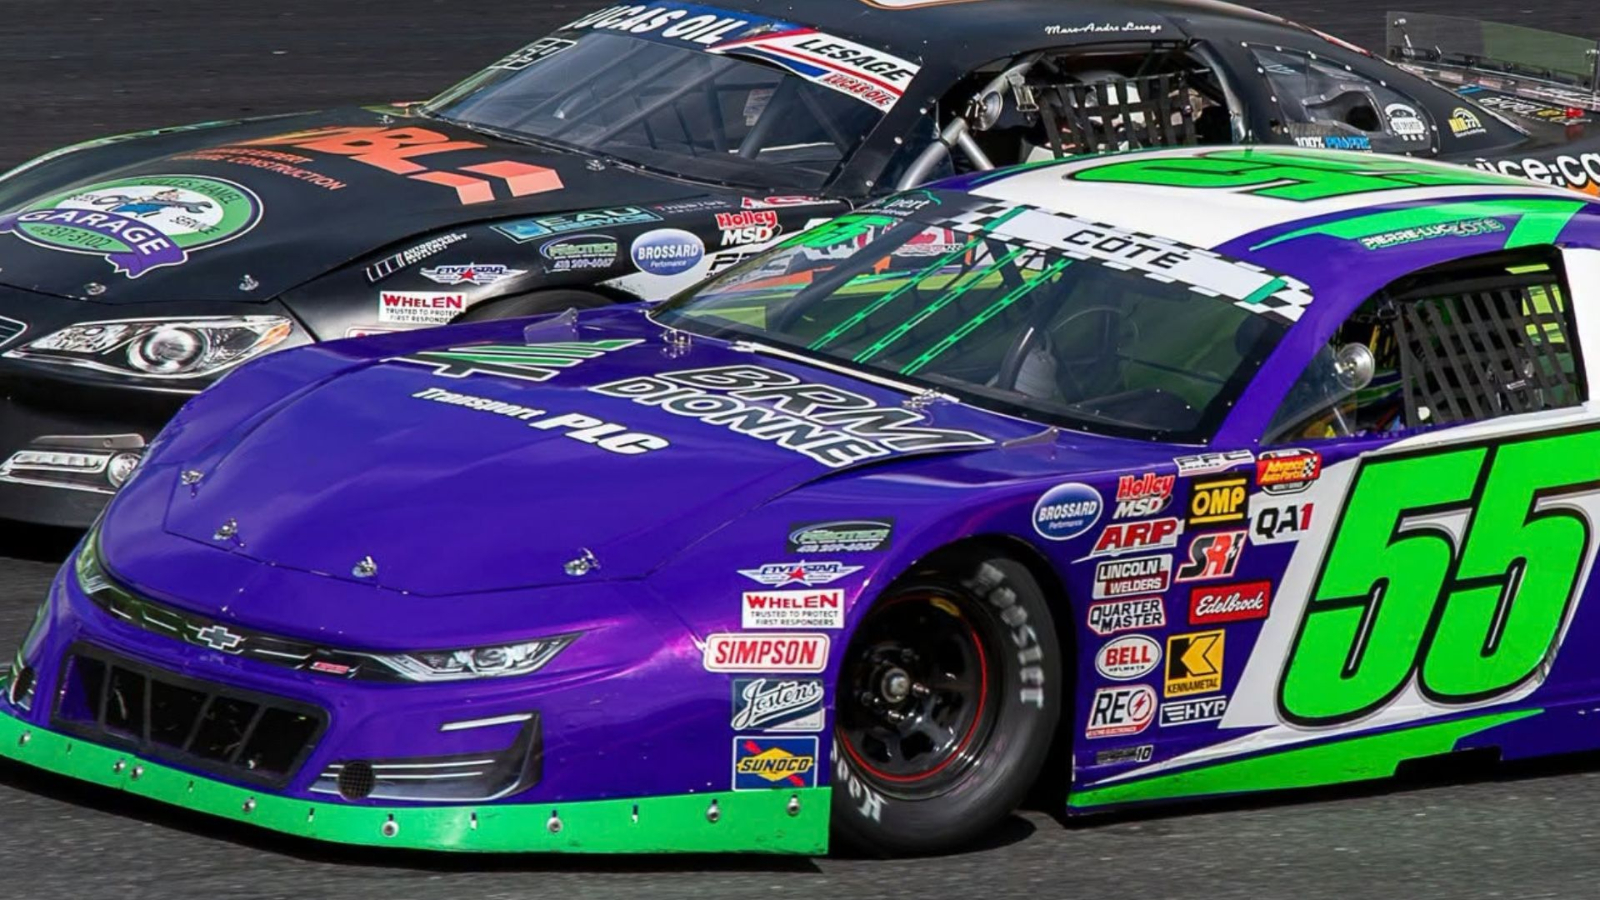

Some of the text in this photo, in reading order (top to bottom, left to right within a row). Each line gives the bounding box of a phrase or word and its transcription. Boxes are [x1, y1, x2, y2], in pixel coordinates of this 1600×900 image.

[557, 5, 748, 45] LUCAS OIL
[793, 38, 916, 81] LESAGE
[822, 73, 894, 108] LUCAS OIL
[715, 210, 778, 230] Holley
[17, 208, 171, 255] GARAGE
[721, 228, 774, 246] MSD
[638, 244, 698, 259] BROSSARD
[472, 265, 504, 274] STAR
[650, 260, 687, 268] Performance
[383, 293, 463, 309] WHELEN
[385, 308, 418, 316] TRUSTED
[412, 387, 546, 420] Transport
[655, 366, 995, 450] BRM
[588, 377, 891, 467] DIONNE
[529, 413, 670, 455] PLC
[1116, 473, 1175, 500] Holley
[1039, 501, 1097, 521] BROSSARD
[1113, 498, 1164, 519] MSD
[1192, 487, 1245, 517] OMP
[1049, 519, 1084, 530] Performance
[1255, 502, 1313, 539] QA1
[1094, 519, 1178, 551] ARP
[803, 564, 840, 574] STAR
[1100, 558, 1158, 580] LINCOLN
[1276, 424, 1600, 728] 55
[1110, 578, 1162, 595] WELDERS
[746, 592, 839, 609] WHELEN
[1195, 591, 1264, 616] Edelbrock
[751, 610, 788, 618] TRUSTED
[789, 610, 800, 618] TO
[756, 618, 835, 626] FIRST RESPONDERS
[1089, 599, 1160, 626] QUARTER
[1100, 612, 1163, 633] MASTER
[715, 640, 818, 665] SIMPSON
[1105, 645, 1152, 667] BELL
[1167, 679, 1219, 694] KENNAMETAL
[731, 678, 824, 730] Jostens
[741, 758, 811, 772] SUNOCO
